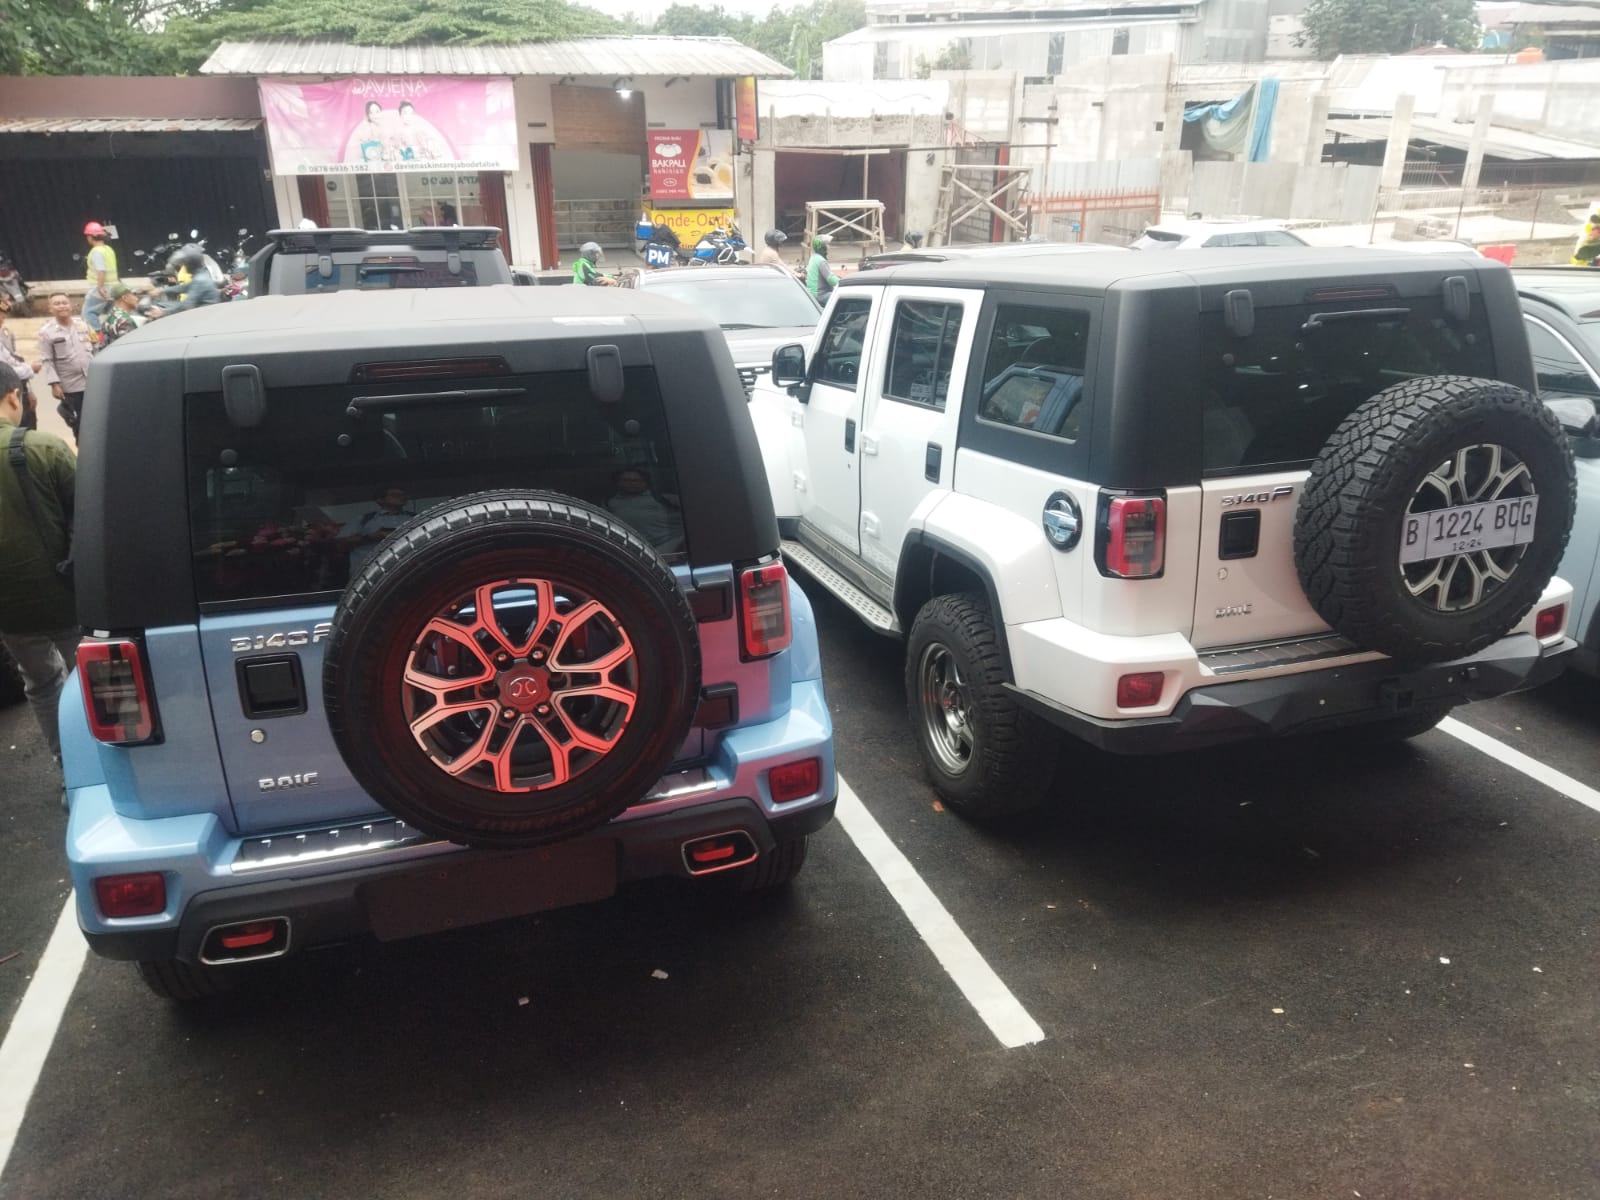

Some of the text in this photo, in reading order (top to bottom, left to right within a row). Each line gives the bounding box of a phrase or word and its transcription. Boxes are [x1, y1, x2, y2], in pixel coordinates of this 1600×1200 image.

[351, 79, 428, 95] DAVIENA
[648, 249, 669, 264] PM
[1406, 519, 1419, 546] B
[1433, 507, 1485, 541] 1224
